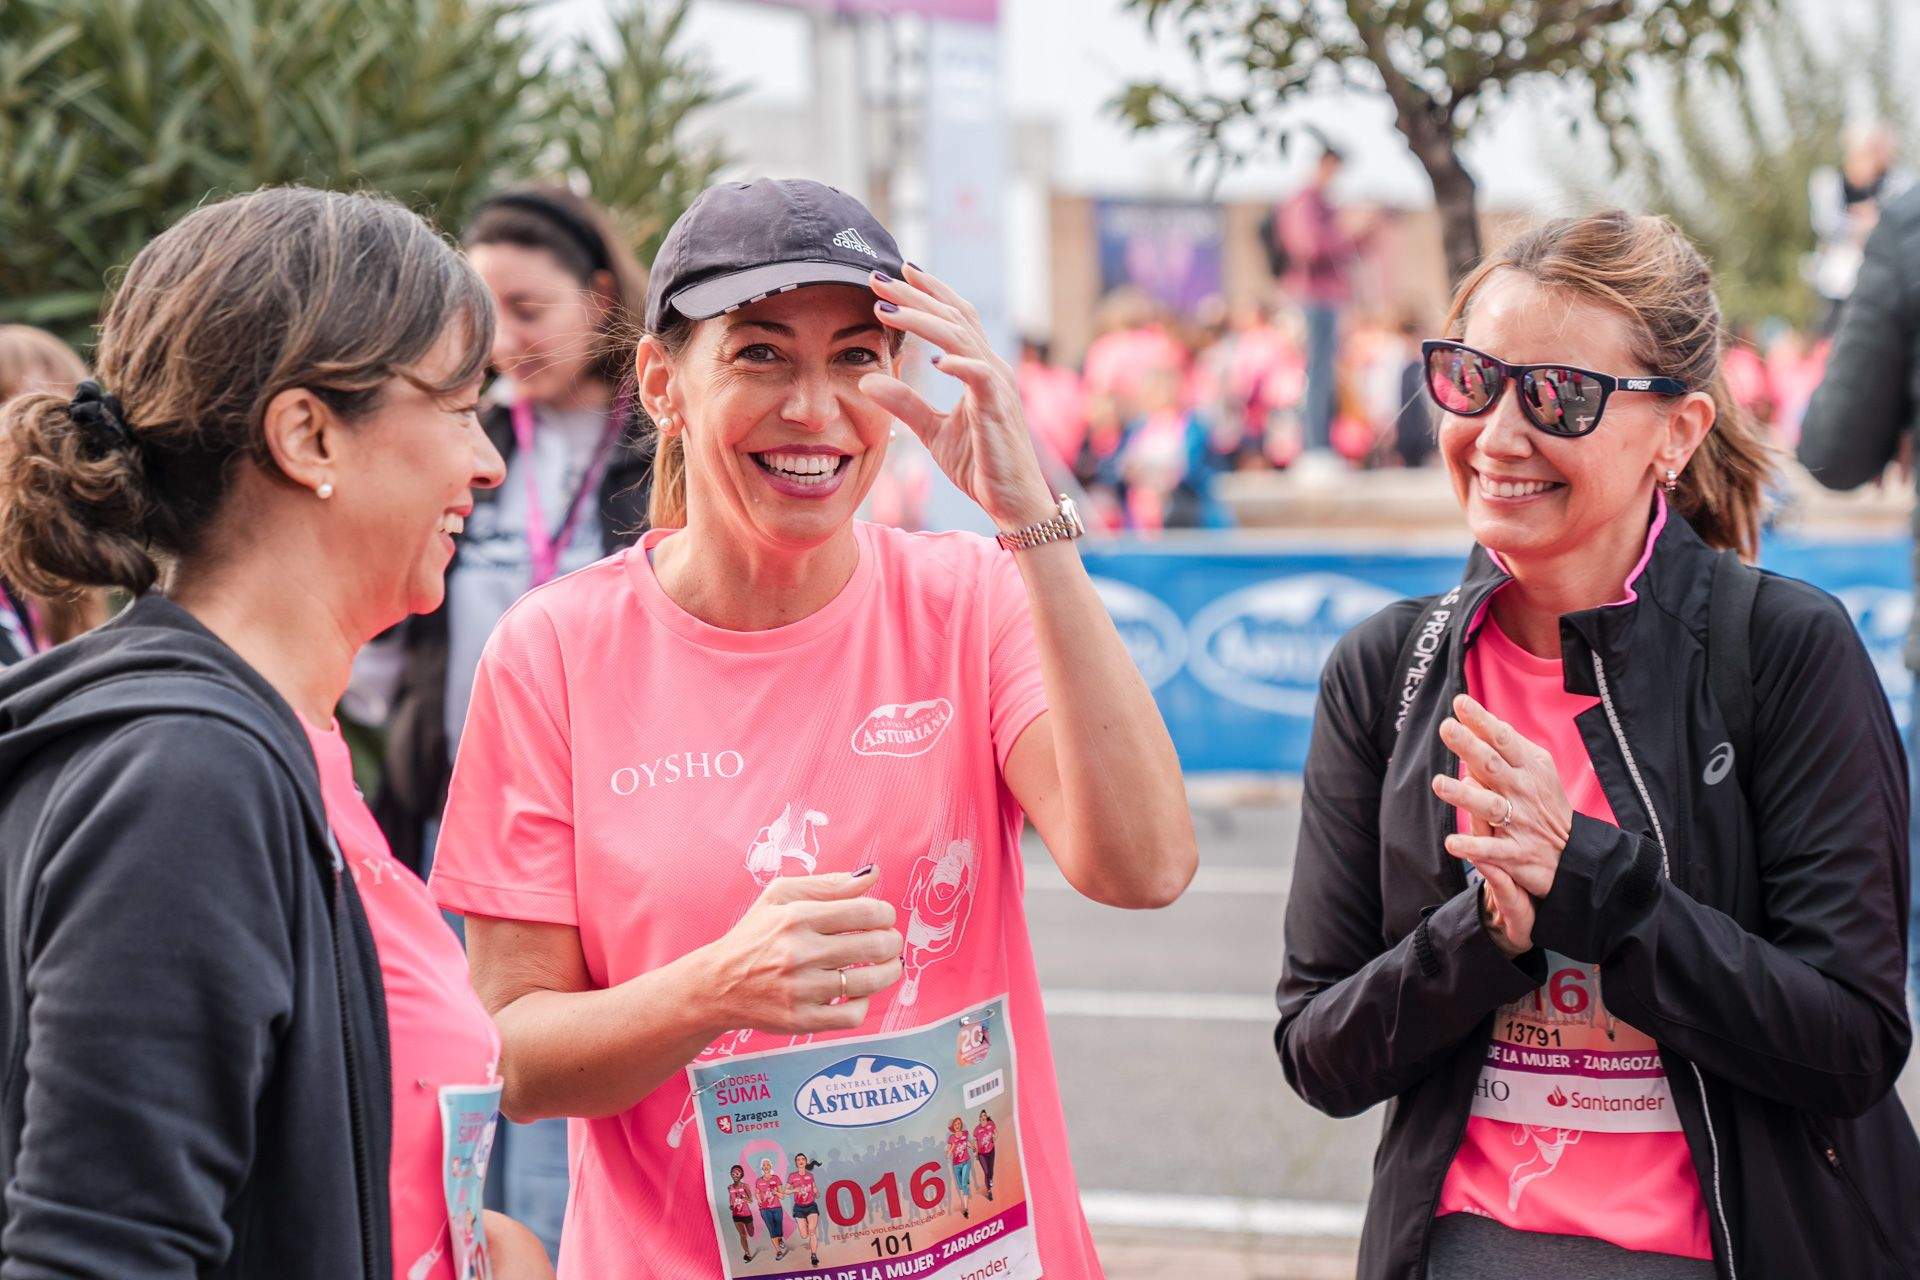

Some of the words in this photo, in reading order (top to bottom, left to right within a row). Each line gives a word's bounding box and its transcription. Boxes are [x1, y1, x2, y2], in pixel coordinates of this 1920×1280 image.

[832, 237, 878, 259] adidas
[863, 710, 947, 751] ASTURIANA
[610, 750, 744, 795] OYSHO
[1506, 1021, 1561, 1047] 13791
[1487, 1044, 1501, 1060] DE
[1503, 1048, 1519, 1064] LA
[1522, 1052, 1571, 1068] MUJER
[1583, 1055, 1663, 1072] ZARAGOZA
[729, 1072, 769, 1087] DORSAL
[826, 1079, 872, 1092] CENTRAL
[876, 1070, 924, 1085] LECHERA
[716, 1084, 771, 1106] SUMA
[806, 1080, 931, 1116] ASTURIANA
[1571, 1092, 1665, 1112] Santander
[735, 1110, 778, 1122] Zaragoza
[736, 1121, 780, 1133] DEPORTE
[825, 1161, 946, 1227] 016
[862, 1266, 880, 1280] LA
[885, 1254, 935, 1280] MUJER
[942, 1219, 1005, 1259] ZARAGOZA
[871, 1232, 913, 1257] 101
